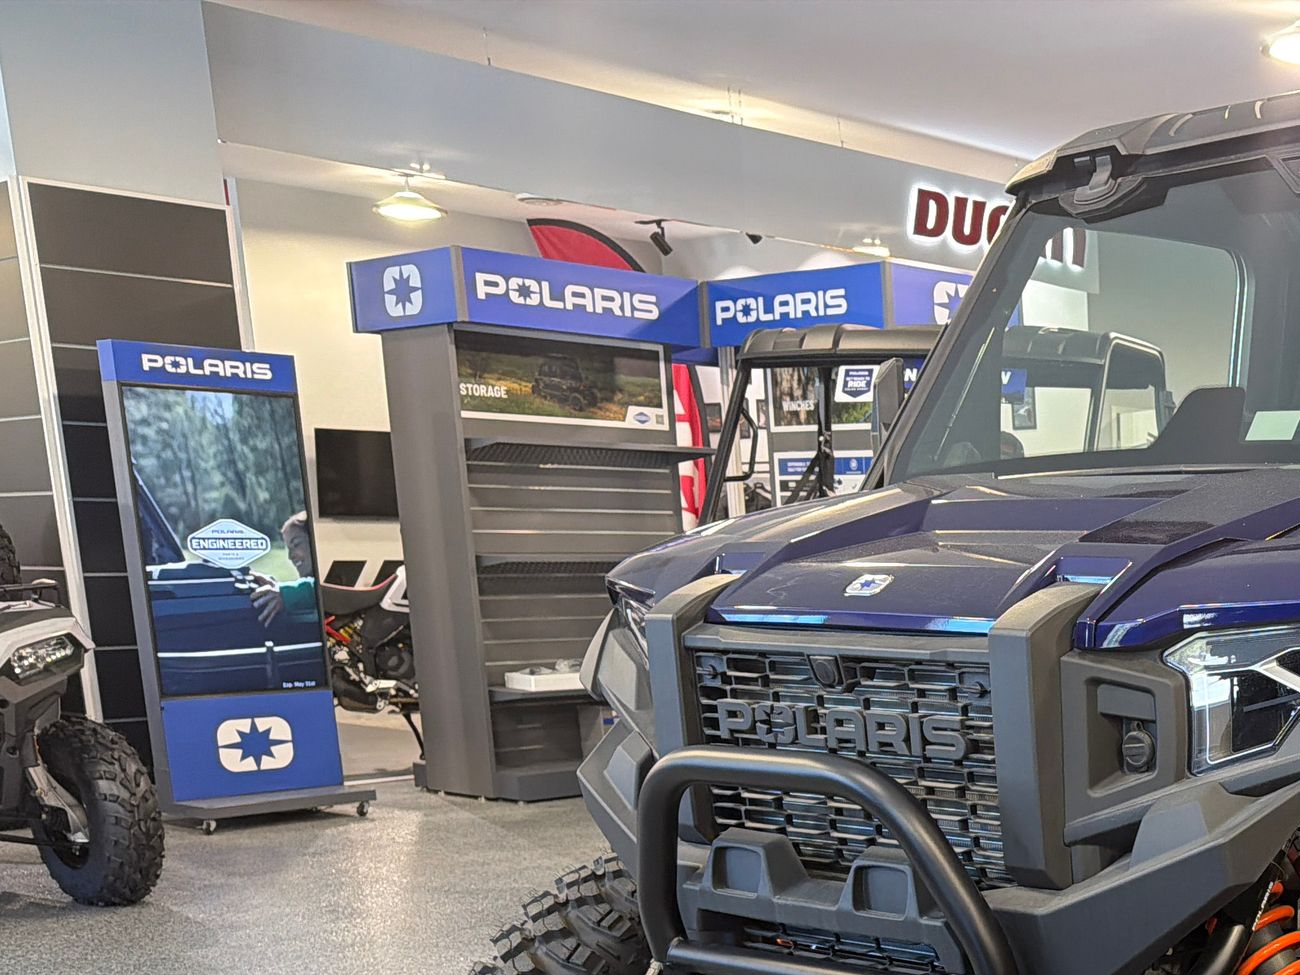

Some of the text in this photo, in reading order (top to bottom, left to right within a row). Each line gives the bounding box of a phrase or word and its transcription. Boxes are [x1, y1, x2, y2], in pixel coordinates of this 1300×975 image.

[475, 271, 660, 321] POLARIS
[715, 288, 848, 326] POLARIS
[141, 353, 273, 380] POLARIS
[459, 382, 508, 399] STORAGE
[782, 401, 815, 411] WINCHES
[191, 538, 267, 549] ENGINEERED
[716, 698, 970, 761] POLARIS
